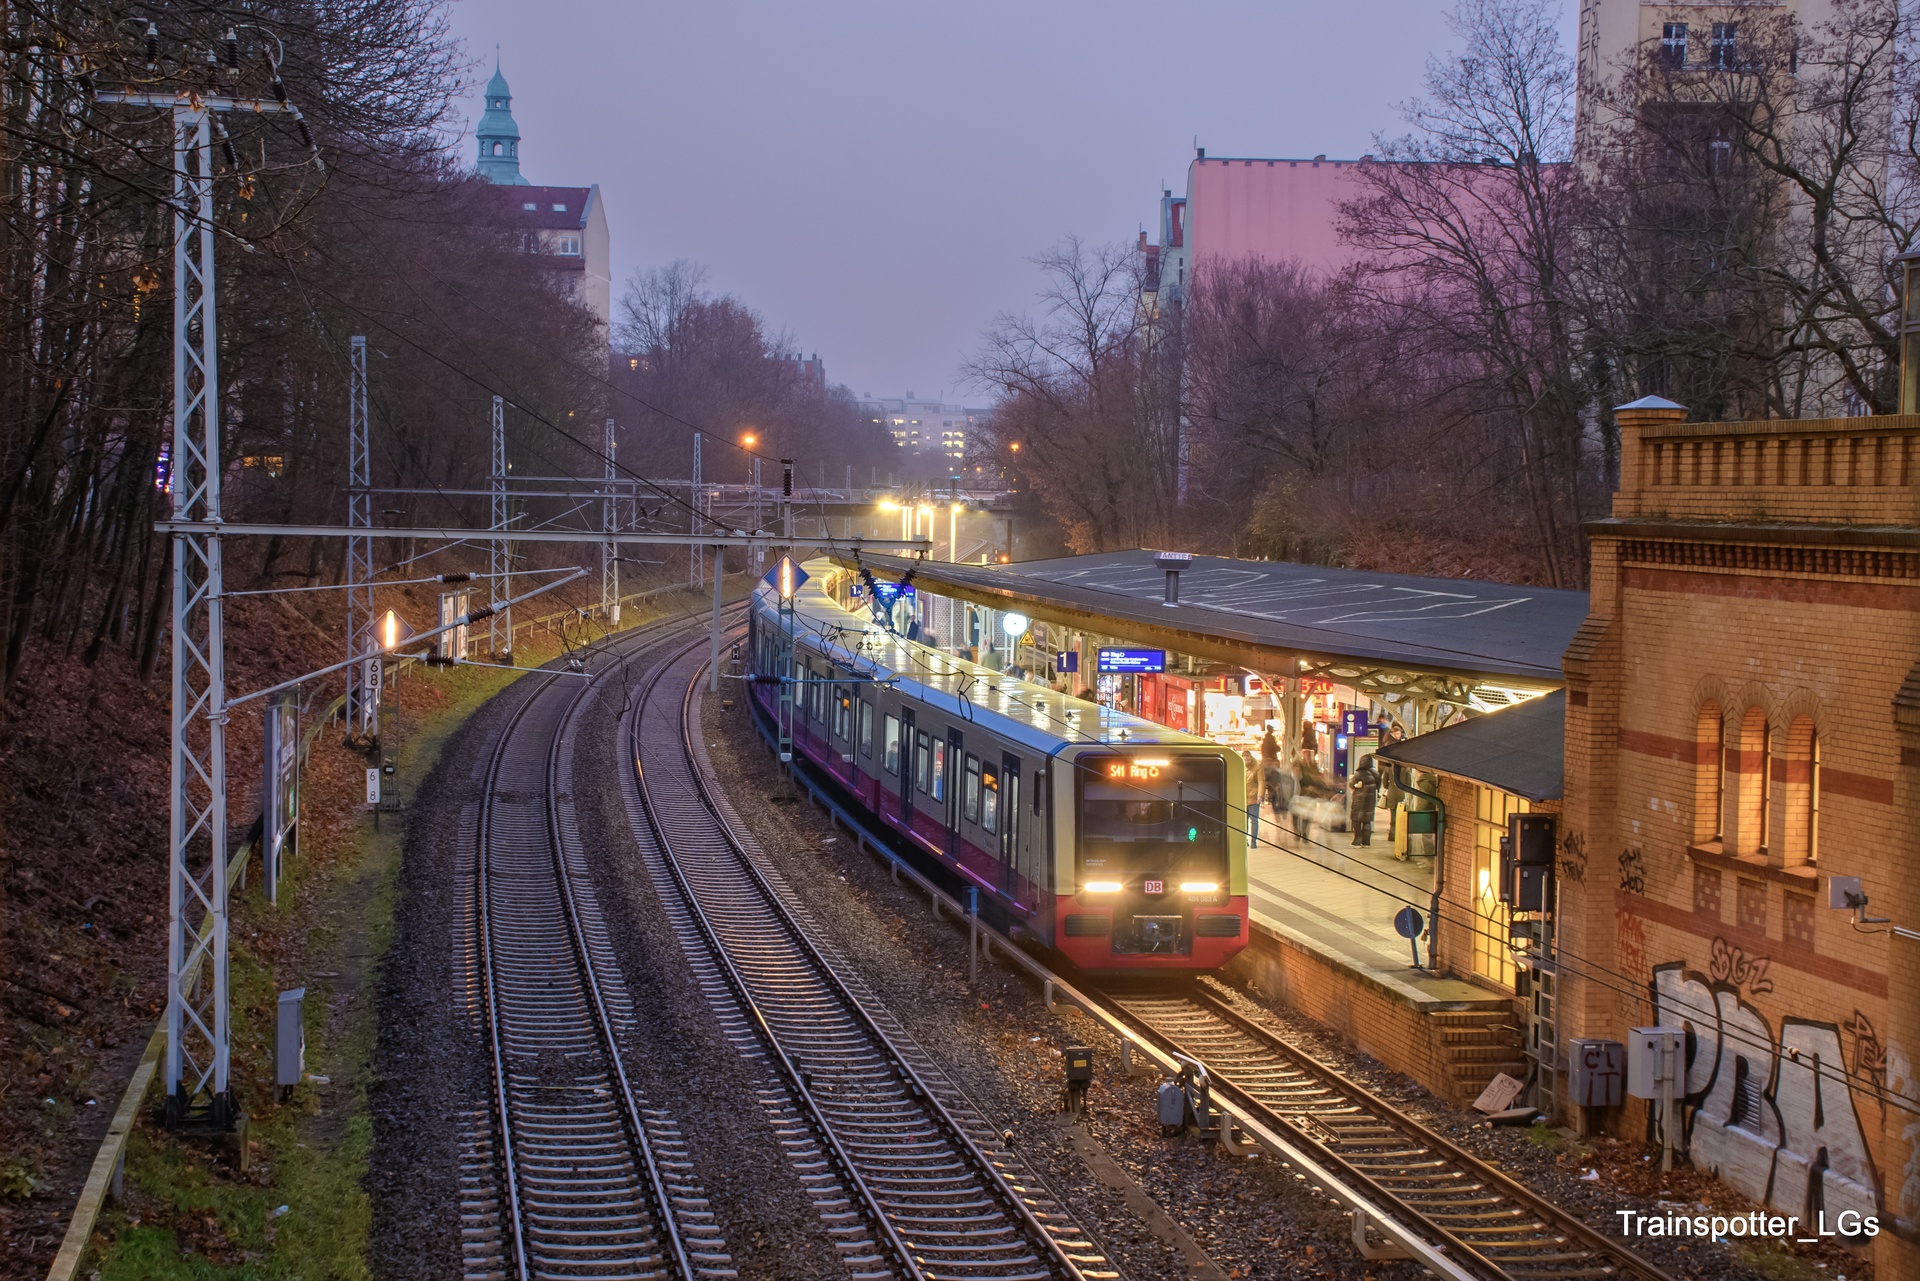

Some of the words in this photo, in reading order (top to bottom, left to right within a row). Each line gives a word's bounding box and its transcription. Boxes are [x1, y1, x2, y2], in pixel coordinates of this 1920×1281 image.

[1060, 652, 1067, 668] 1
[1110, 765, 1125, 777] S41
[1146, 882, 1162, 892] DB
